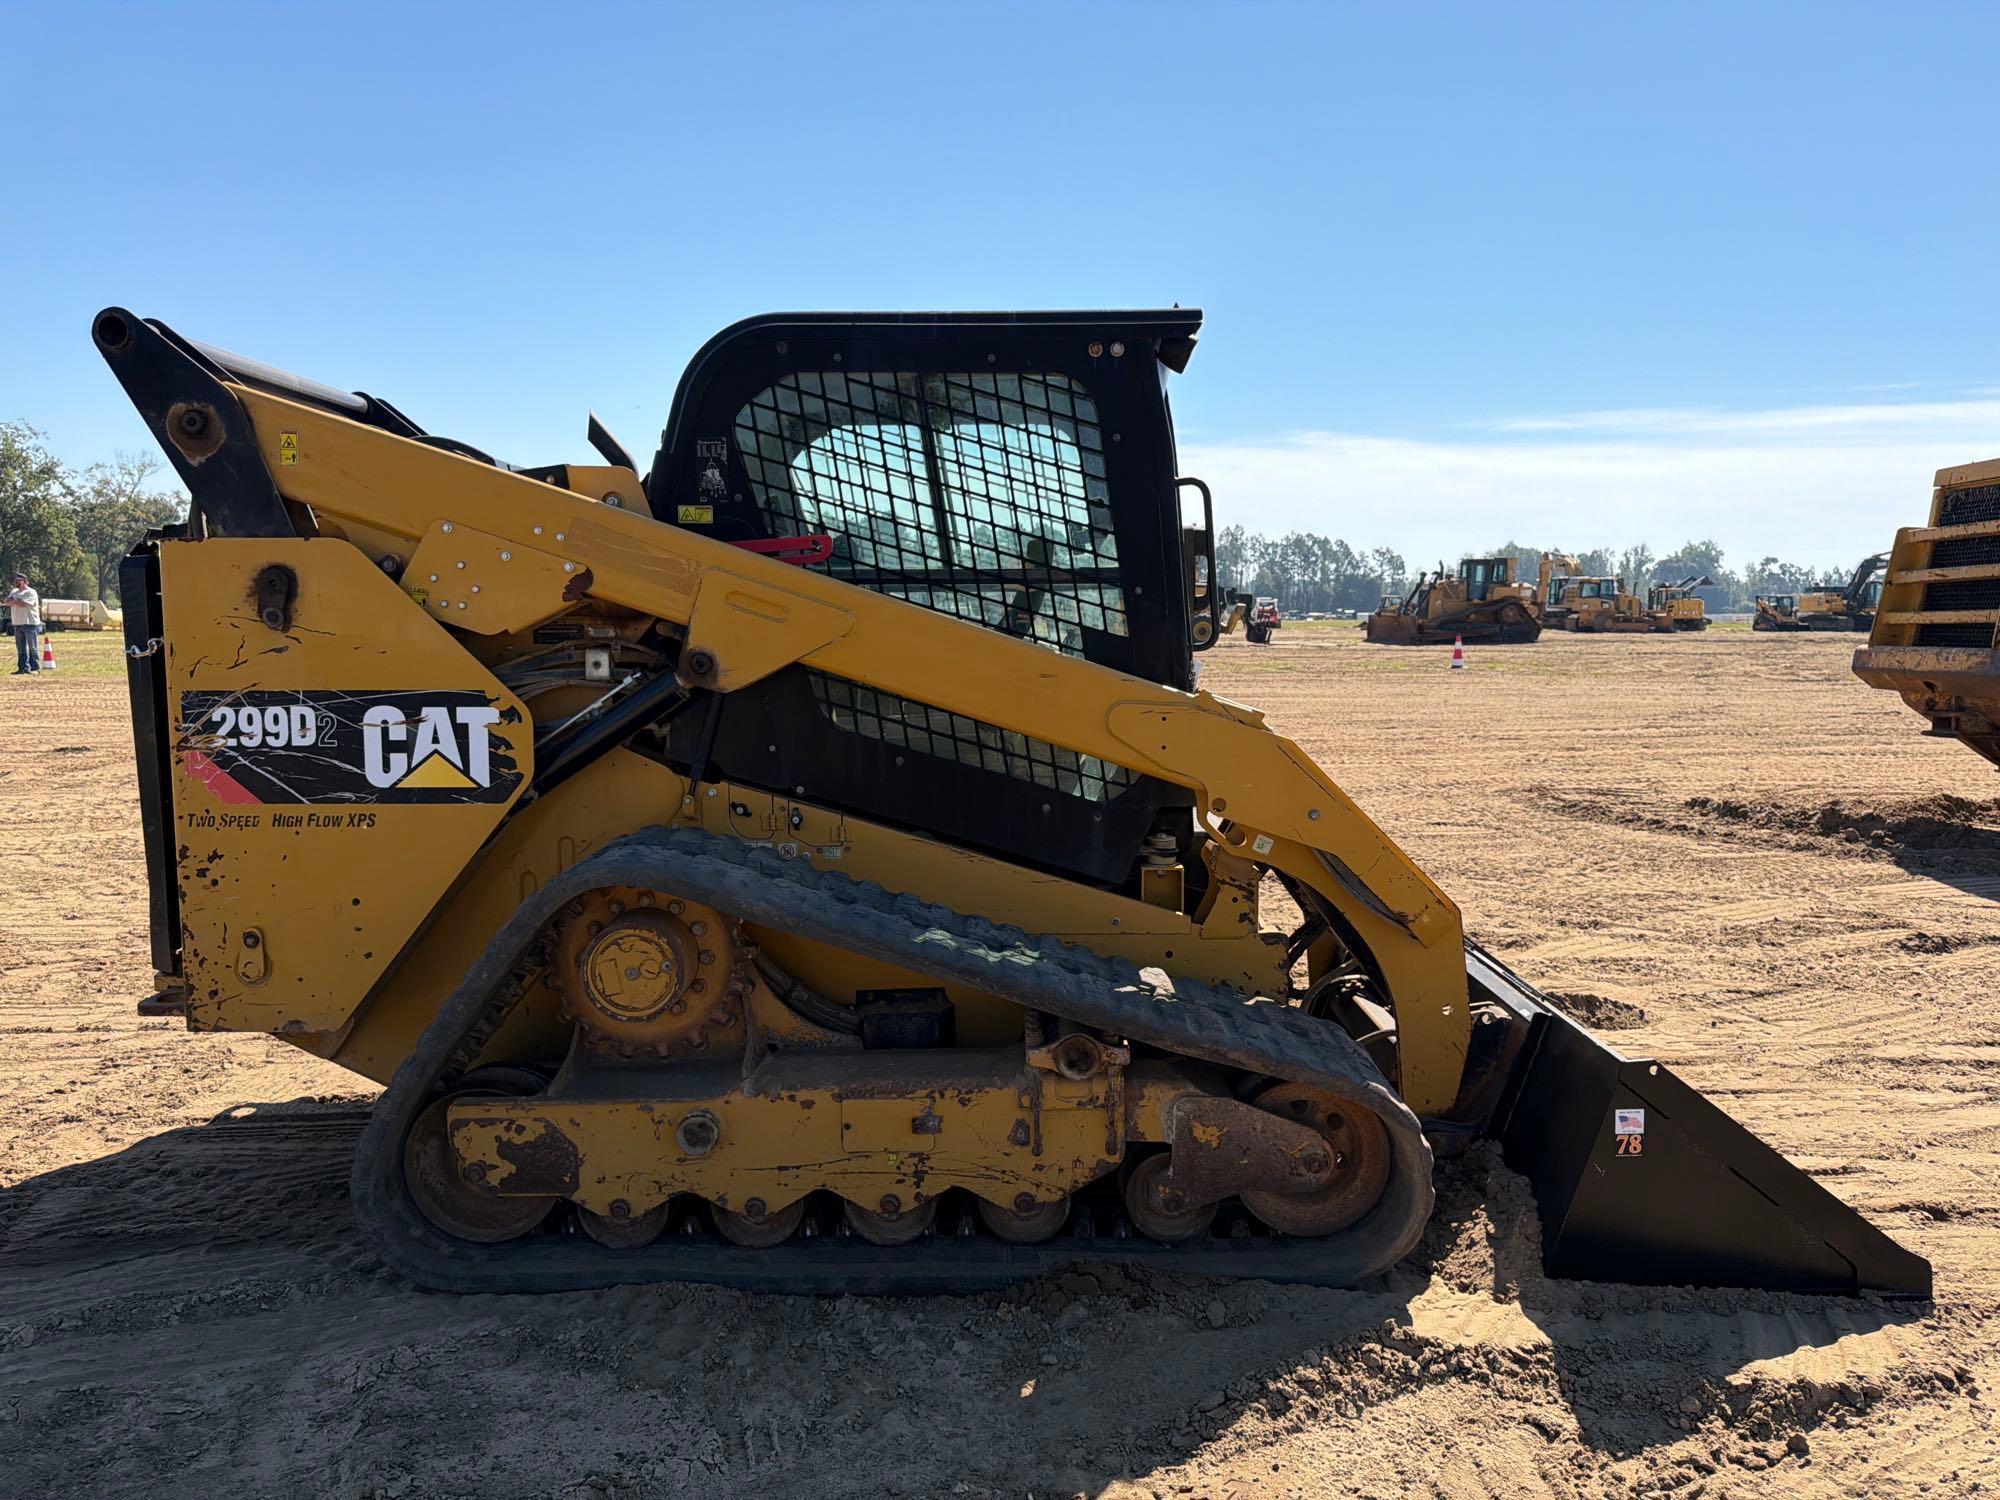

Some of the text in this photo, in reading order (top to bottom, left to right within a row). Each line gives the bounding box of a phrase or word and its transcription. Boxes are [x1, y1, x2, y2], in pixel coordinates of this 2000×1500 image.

[363, 705, 500, 788] CAT
[346, 813, 377, 828] XPS
[1616, 1134, 1642, 1154] 78
